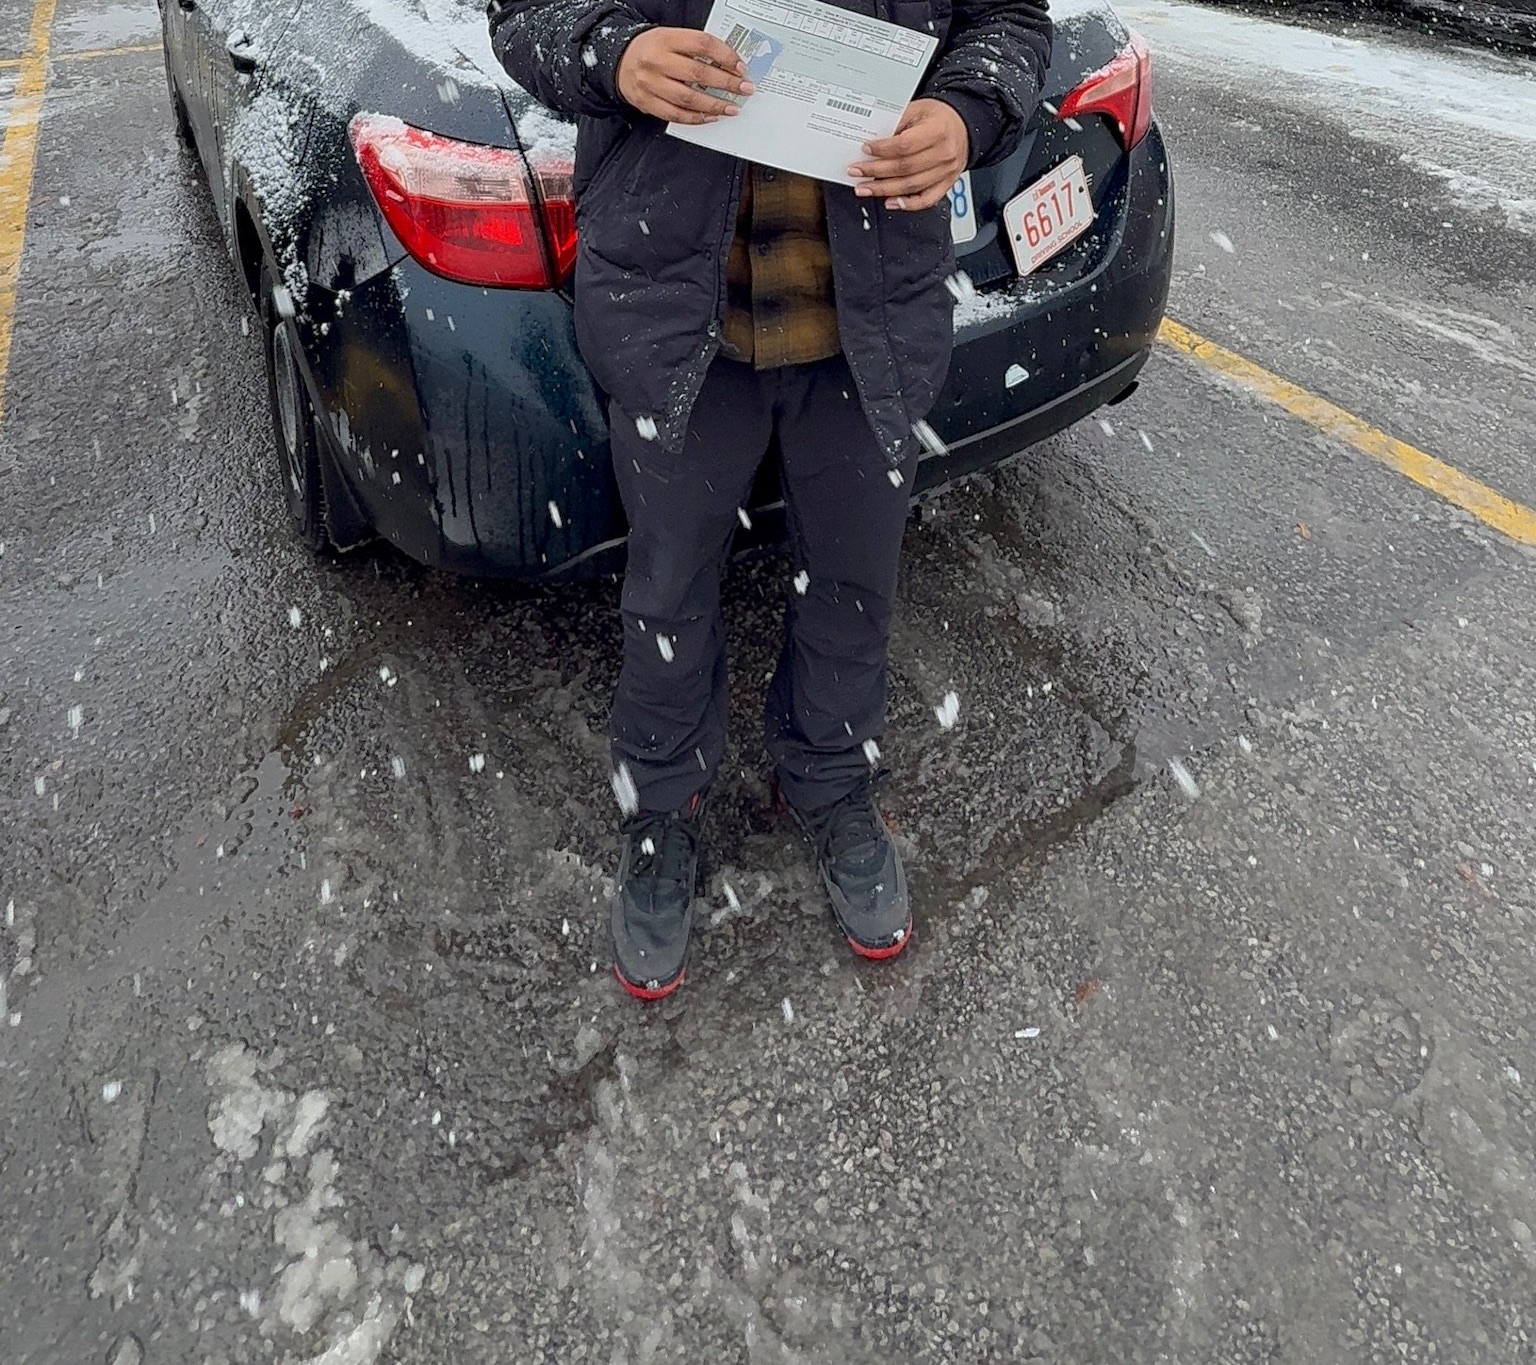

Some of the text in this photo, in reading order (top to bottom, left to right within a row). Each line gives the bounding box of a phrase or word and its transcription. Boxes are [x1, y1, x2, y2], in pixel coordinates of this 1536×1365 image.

[1023, 181, 1073, 247] 6617
[1031, 220, 1083, 263] DRIVING SCHOOL
